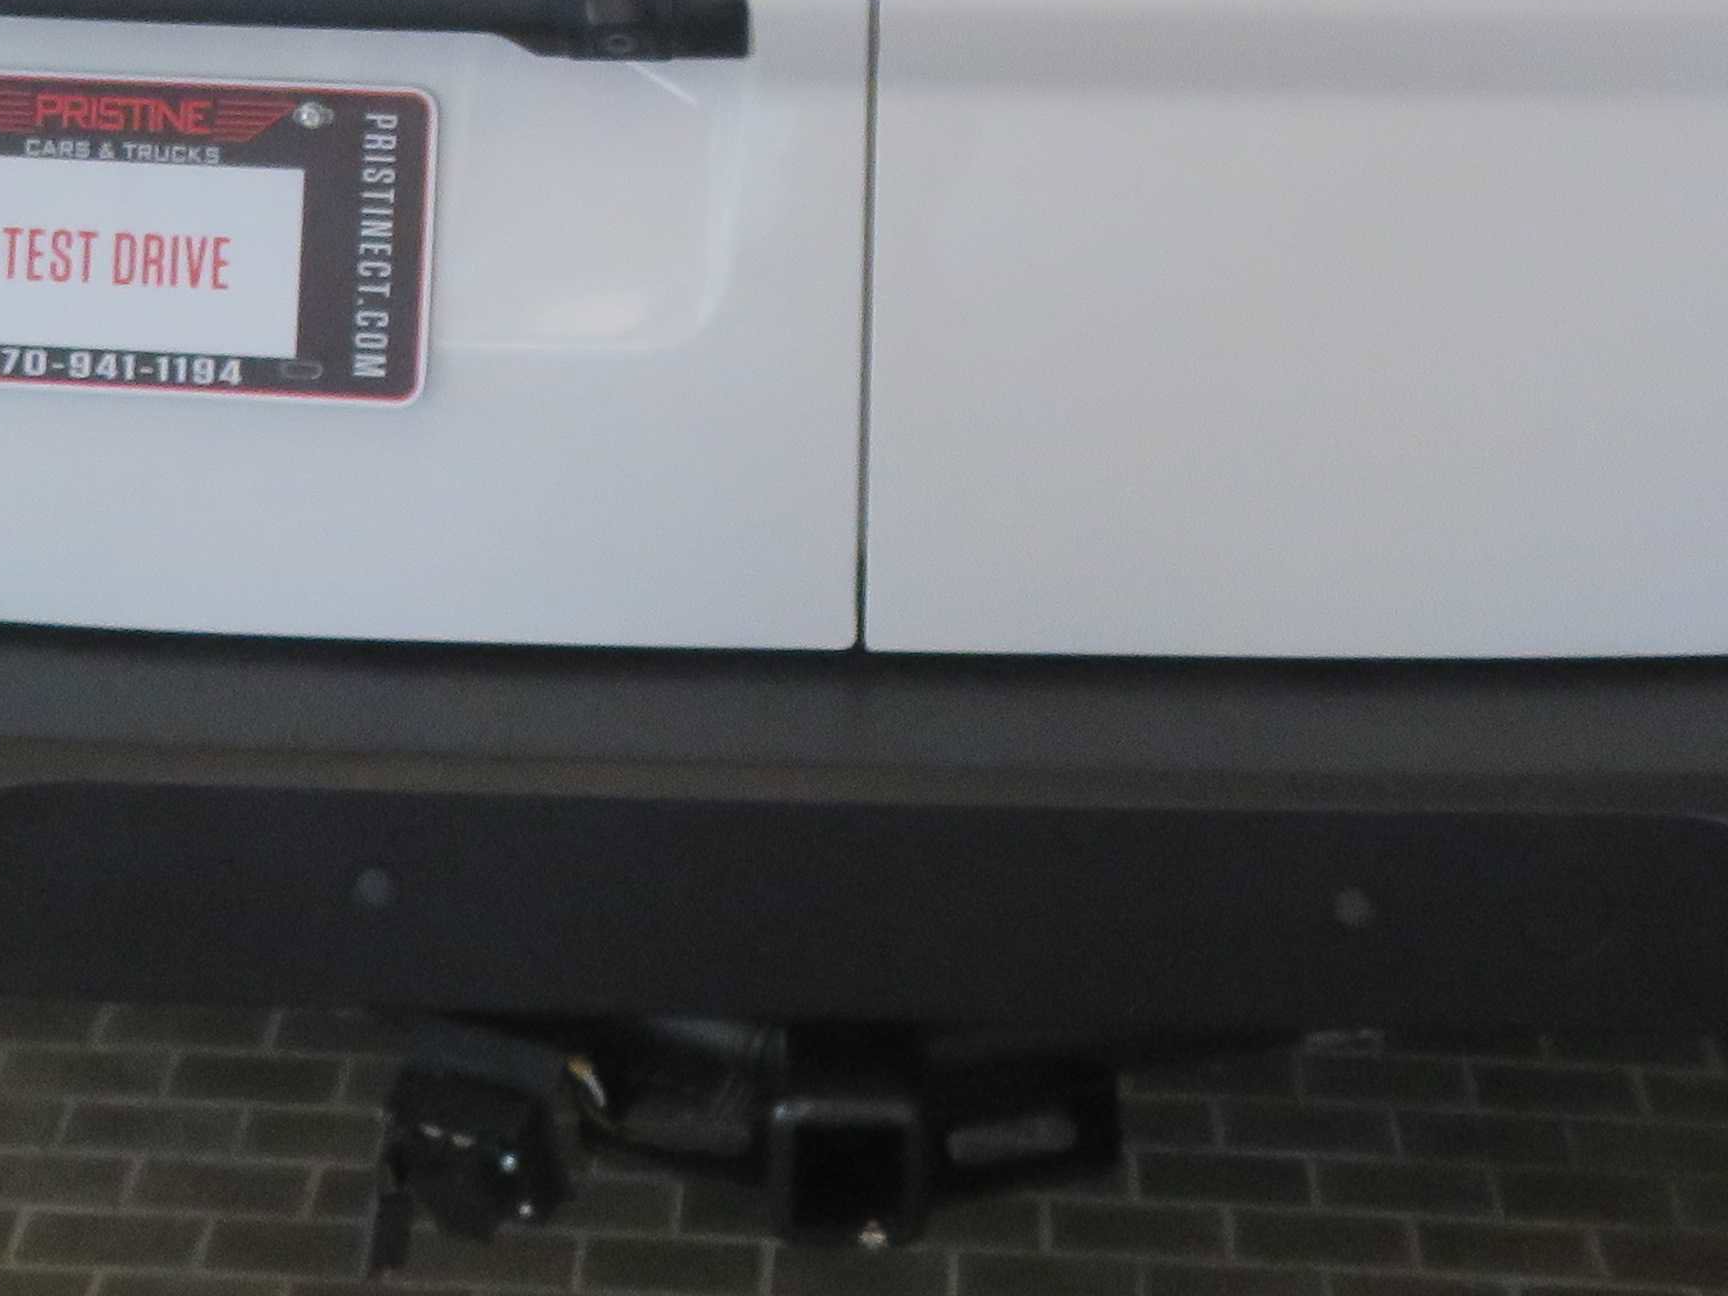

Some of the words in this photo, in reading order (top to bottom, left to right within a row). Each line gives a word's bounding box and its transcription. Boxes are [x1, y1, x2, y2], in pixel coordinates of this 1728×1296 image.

[34, 93, 216, 134] PRISTINE
[25, 138, 91, 159] CARS
[98, 142, 116, 160] &
[122, 140, 221, 166] TRUCKS
[2, 226, 99, 284] TEST
[112, 232, 231, 291] DRIVE
[352, 112, 399, 379] PRISTINECT.COM
